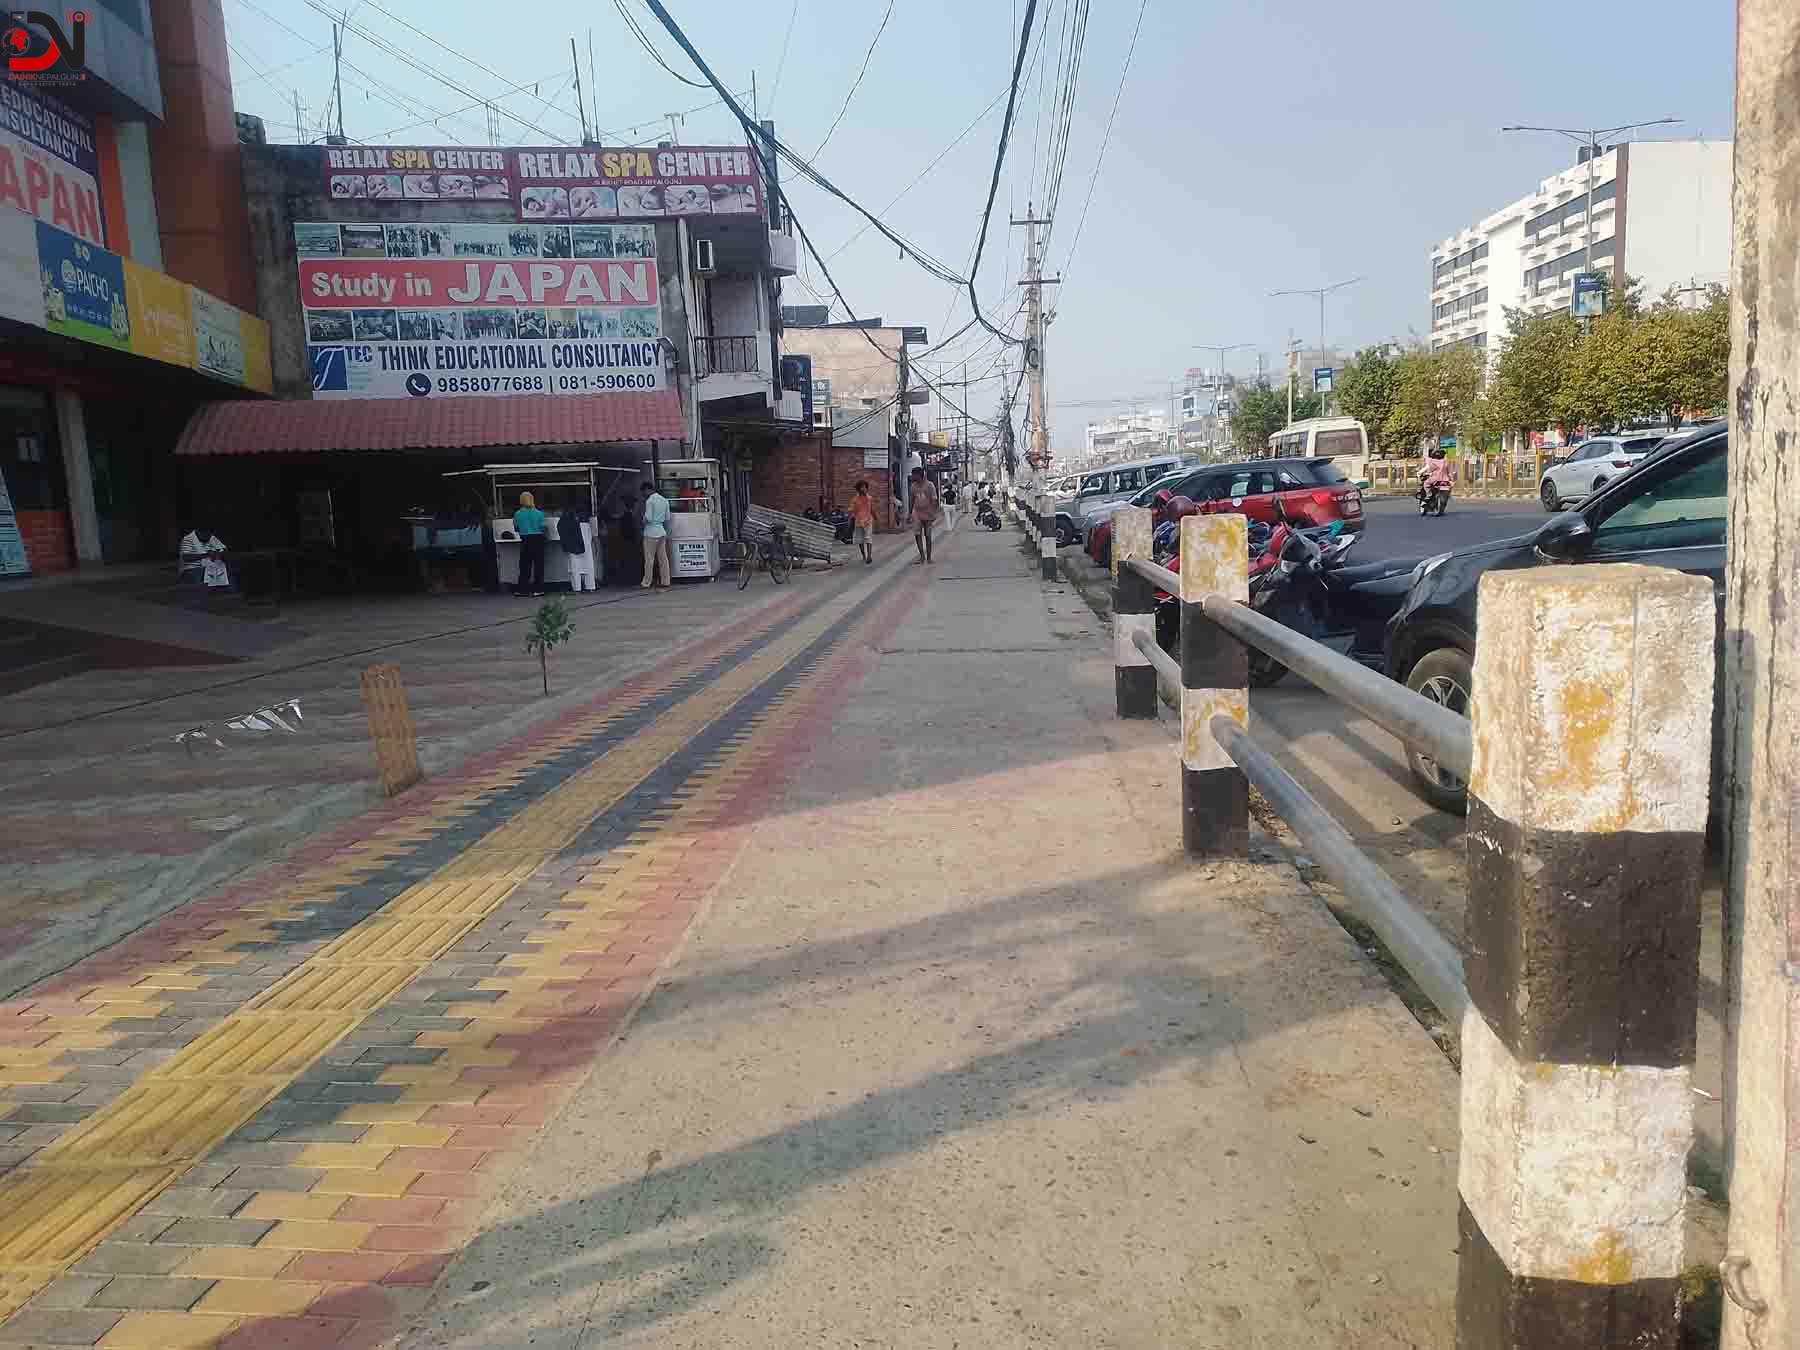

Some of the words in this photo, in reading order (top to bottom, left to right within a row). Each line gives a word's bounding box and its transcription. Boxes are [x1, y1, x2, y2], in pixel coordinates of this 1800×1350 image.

[0, 83, 94, 153] EDUCATIONAL
[328, 150, 389, 168] RELAX
[391, 151, 431, 169] SPA
[433, 151, 504, 169] CENTER
[518, 152, 599, 178] RELAX
[602, 152, 653, 178] SPA
[657, 152, 750, 177] CENTER
[312, 272, 397, 303] Study
[405, 272, 432, 297] in
[447, 263, 649, 303] JAPAN
[378, 346, 431, 370] THINK
[435, 344, 547, 370] EDUCATIONAL
[552, 342, 662, 369] CONSULTANCY
[437, 376, 544, 393] 9858077688
[559, 374, 656, 391] 081-590600
